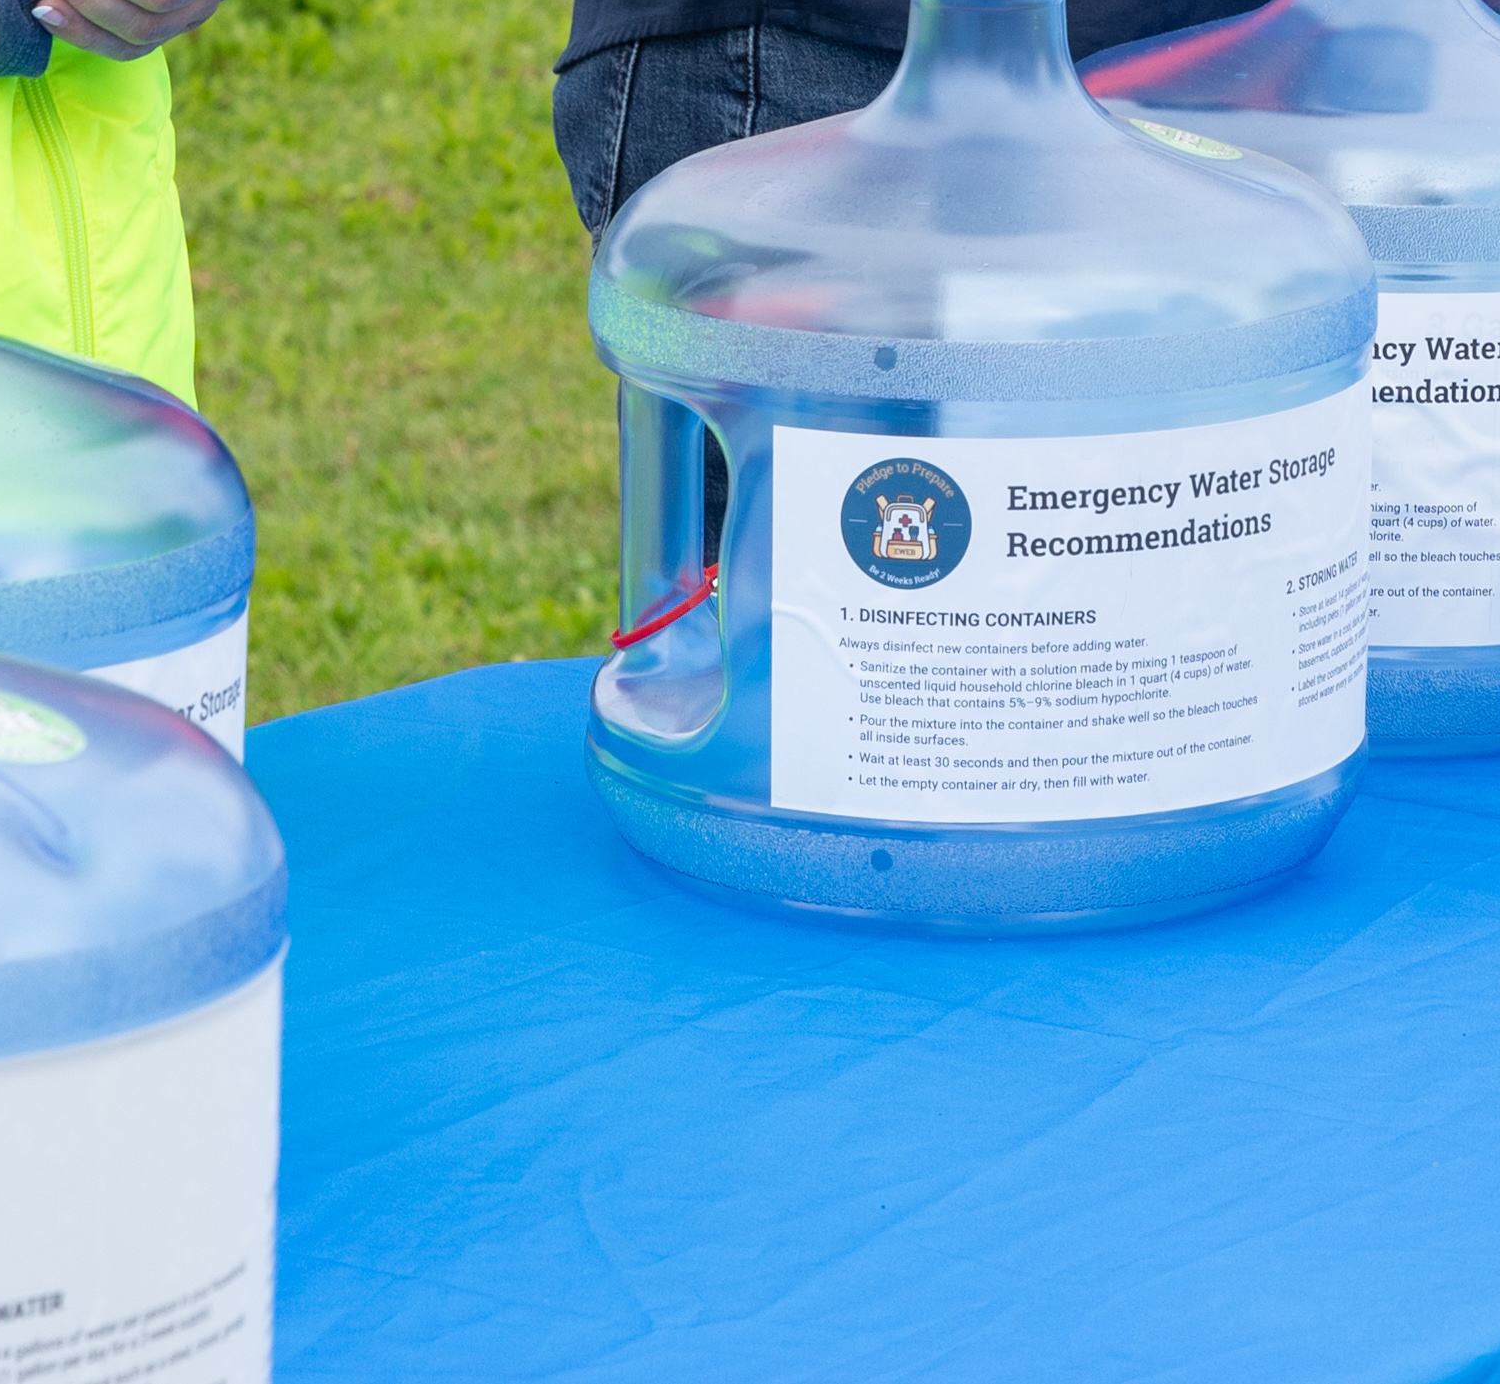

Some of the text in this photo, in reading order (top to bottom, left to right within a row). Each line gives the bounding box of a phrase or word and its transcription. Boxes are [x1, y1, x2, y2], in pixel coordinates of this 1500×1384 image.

[856, 463, 955, 498] Pledge to Prepare
[1008, 448, 1334, 514] Emergency Water Storage
[1007, 514, 1271, 557] Recommendations
[1287, 551, 1357, 594] 2. STORING WATER
[1401, 552, 1418, 562] the
[1421, 552, 1456, 562] bleach
[1459, 551, 1500, 561] touches
[869, 564, 880, 576] Be
[887, 573, 913, 585] Weeks
[914, 568, 941, 585] Ready!
[841, 608, 1096, 627] 1. DISINFECTING CONTAINERS
[839, 637, 1149, 654] Always disinfect new containers before adding water.
[861, 661, 906, 674] Sanitize
[910, 664, 928, 675] the
[932, 666, 987, 676] container
[991, 666, 1016, 676] with
[1031, 664, 1077, 675] solution
[1081, 661, 1112, 673] made
[1116, 660, 1128, 673] by
[1132, 658, 1167, 669] mixing
[1180, 650, 1225, 664] teaspoon
[1228, 645, 1237, 656] of
[860, 680, 920, 690] unscented
[925, 680, 956, 693] liquid
[960, 681, 1022, 692] household
[1026, 680, 1072, 692] chlorine
[1076, 677, 1113, 689] bleach
[1117, 677, 1126, 686] in
[1140, 673, 1167, 686] quart
[1171, 670, 1180, 683] (4
[1184, 665, 1211, 679] cups)
[1214, 663, 1224, 674] of
[1226, 660, 1254, 672] water.
[199, 676, 242, 722] Storage
[860, 696, 1257, 730] Pour the mixture into the container and shake well so the bleach touches
[861, 692, 881, 704] Use
[885, 694, 923, 706] bleach
[927, 696, 950, 707] that
[954, 698, 1005, 708] contains
[1056, 695, 1098, 706] sodium
[1102, 689, 1172, 706] hypochlorite.
[860, 731, 969, 746] all inside surfaces.
[860, 735, 1254, 768] Wait at least 30 seconds and then pour the mixture out of the container.
[859, 773, 1150, 791] Let the empty container air dry, then fill with water.
